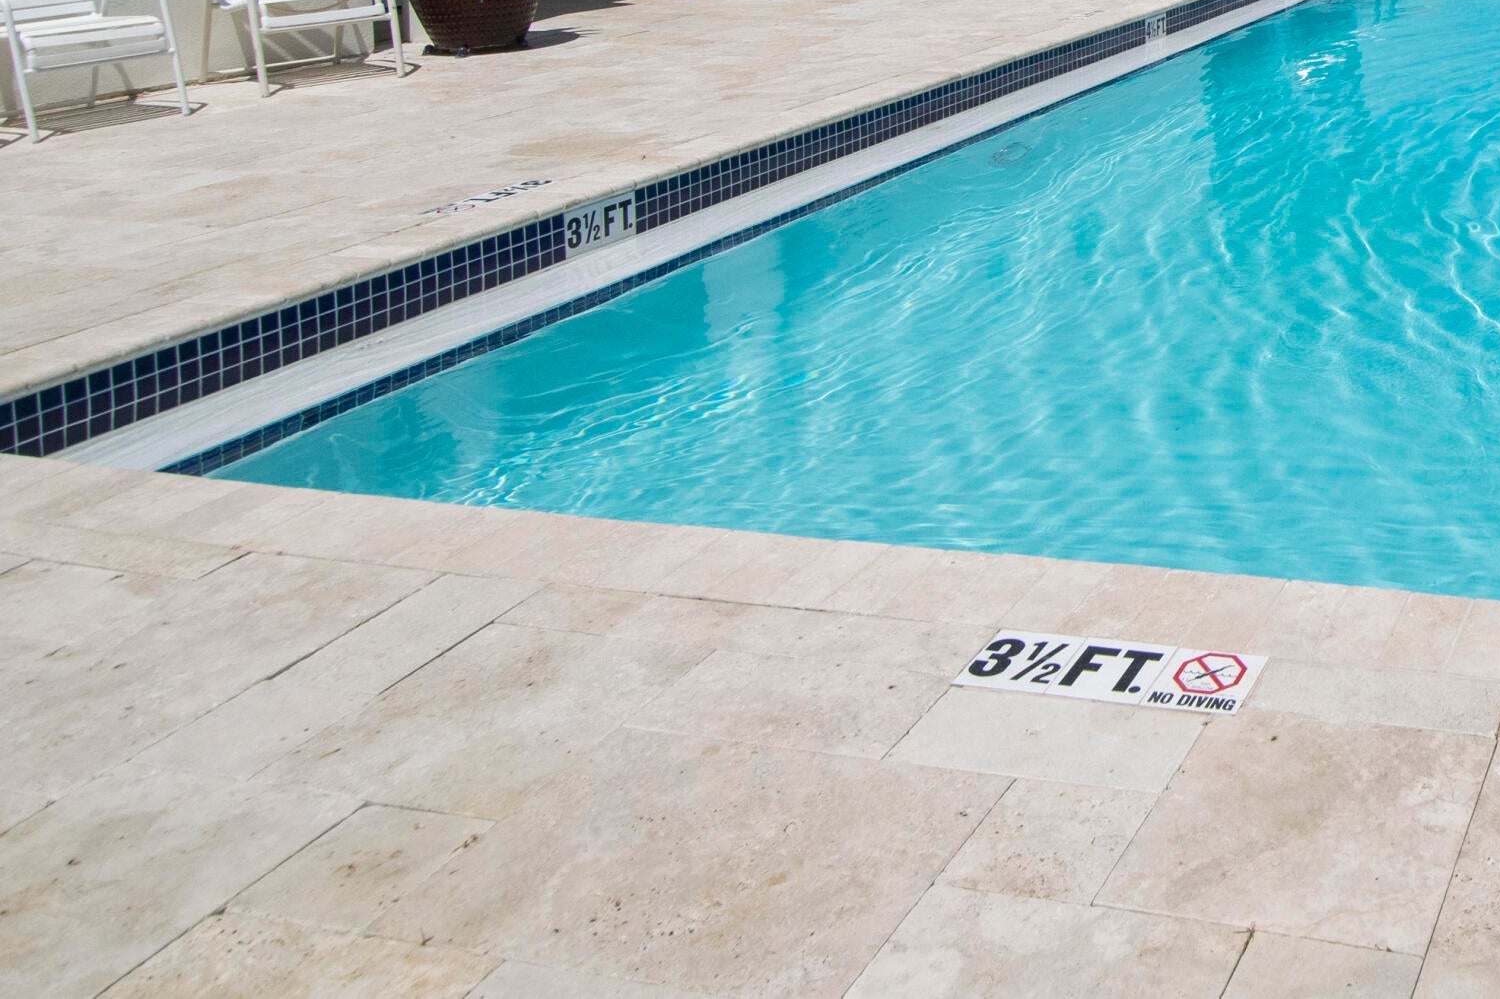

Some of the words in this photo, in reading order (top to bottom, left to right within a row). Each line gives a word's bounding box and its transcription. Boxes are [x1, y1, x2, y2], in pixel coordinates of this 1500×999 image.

[604, 199, 633, 237] FT.
[1058, 645, 1164, 693] FT.
[1147, 691, 1171, 705] NO
[1176, 695, 1237, 711] DIVING
